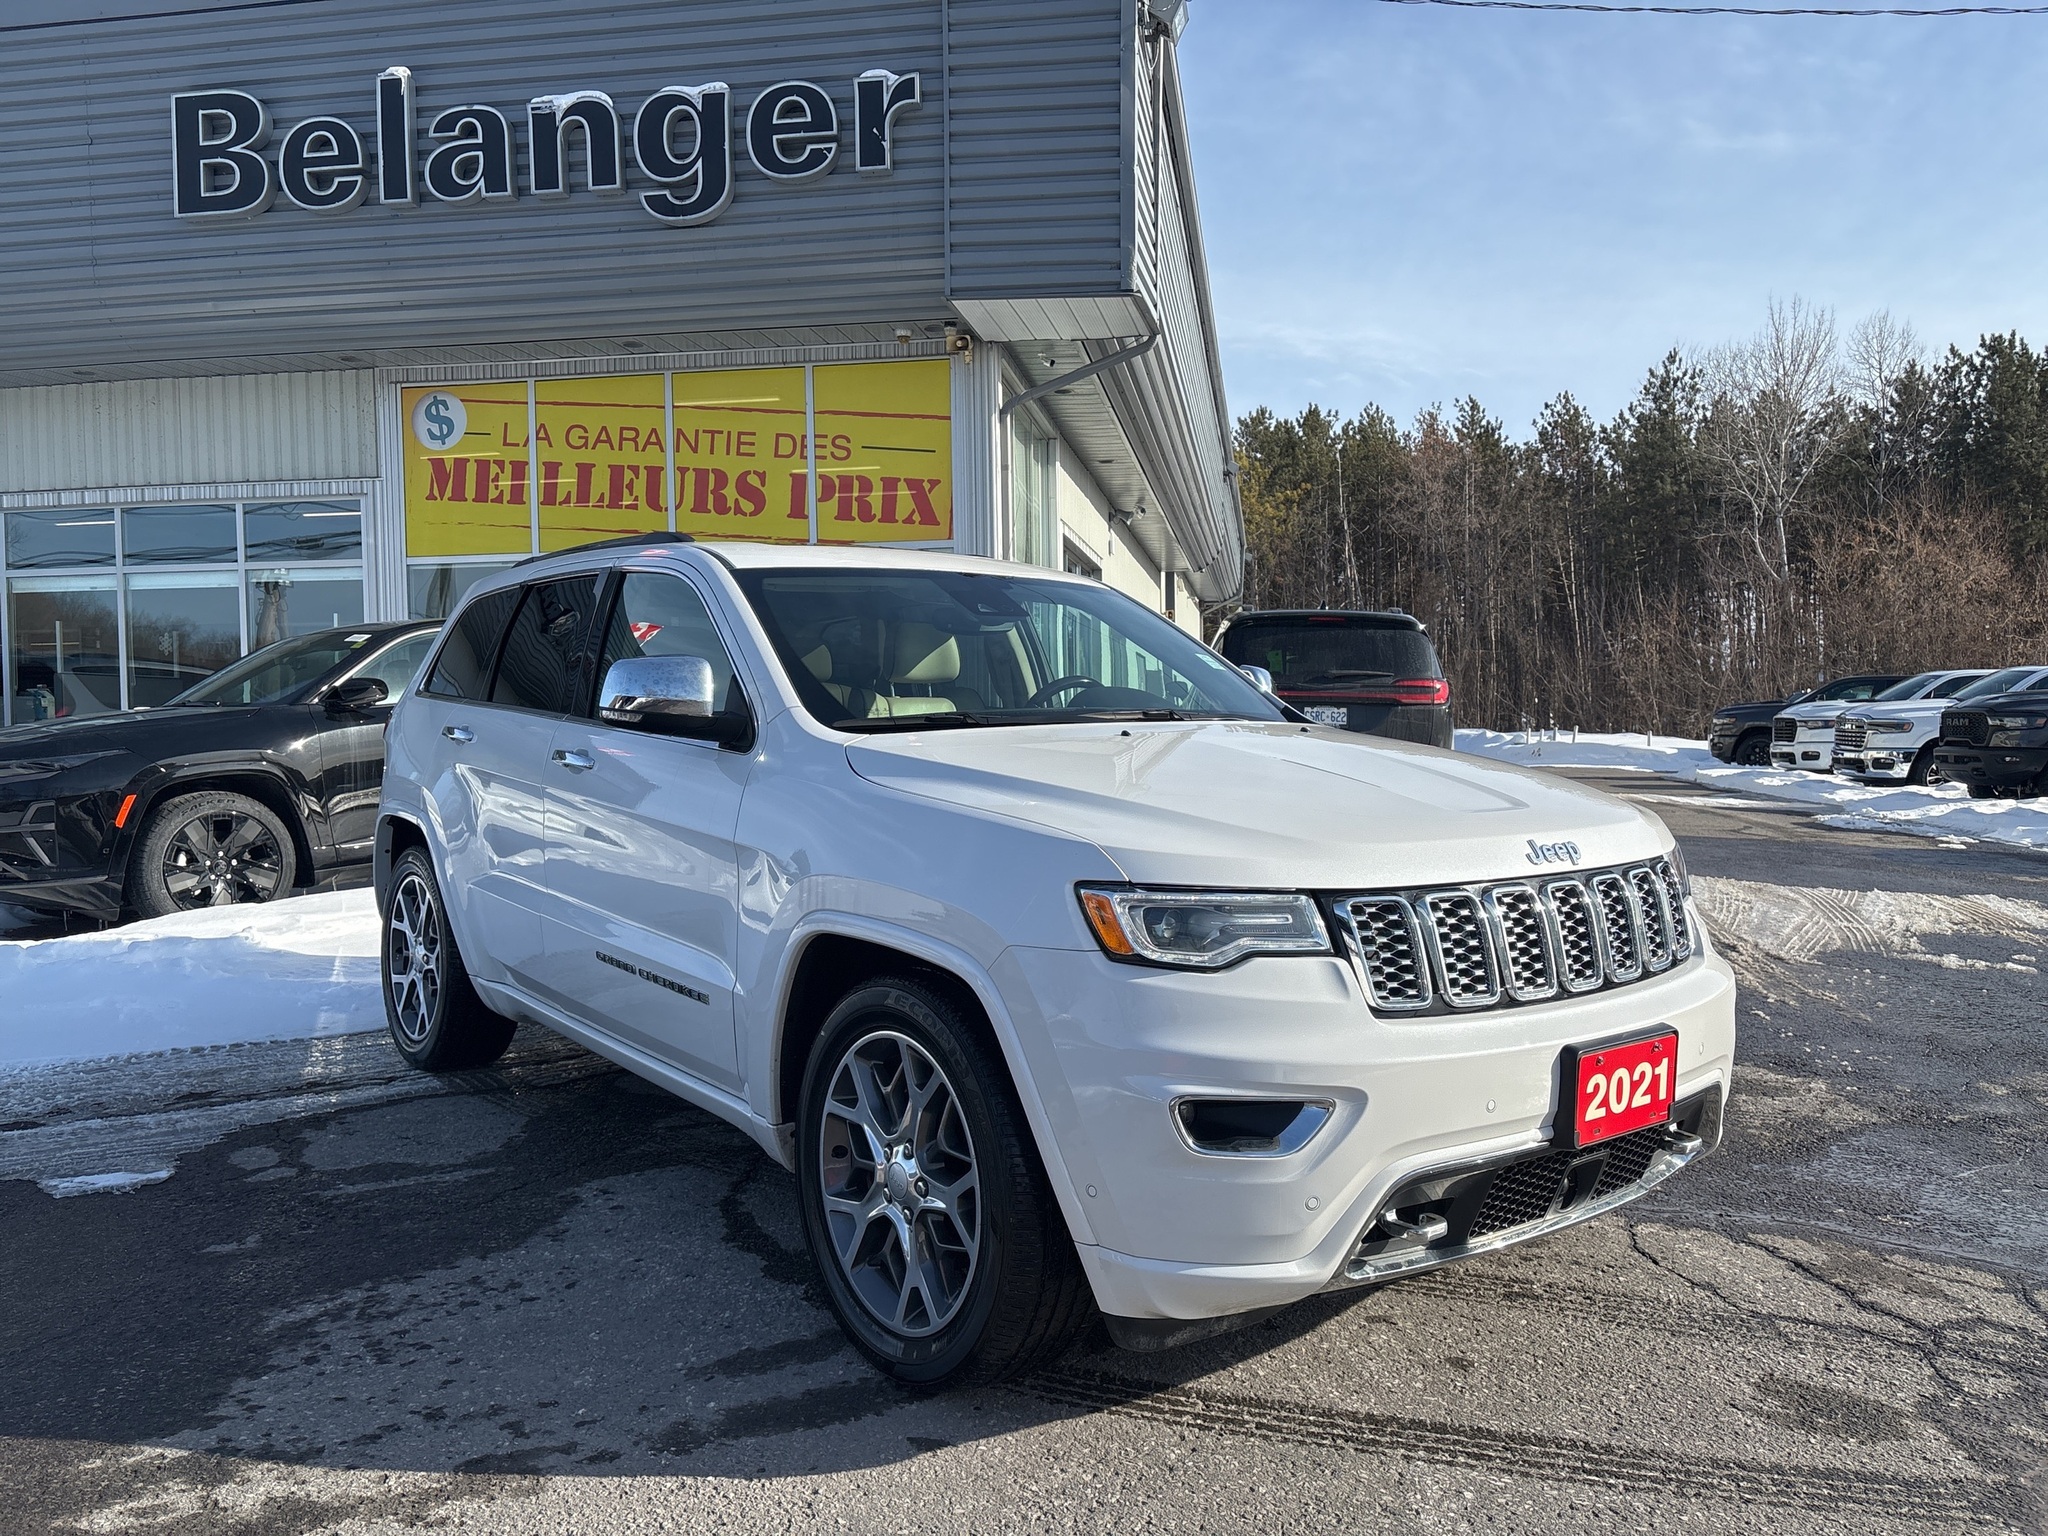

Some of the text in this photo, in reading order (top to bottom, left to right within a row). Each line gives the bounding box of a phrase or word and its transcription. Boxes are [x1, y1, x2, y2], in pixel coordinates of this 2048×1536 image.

[171, 70, 921, 227] Belanger
[502, 423, 853, 461] LA GARANTIE DES
[425, 457, 942, 526] MEILLEURS PRIX
[1330, 711, 1346, 722] 622
[1946, 718, 1969, 726] RAM
[1525, 839, 1582, 866] Jeep
[596, 951, 711, 1006] GRAND CHEROKEE
[1584, 1056, 1670, 1122] 2021
